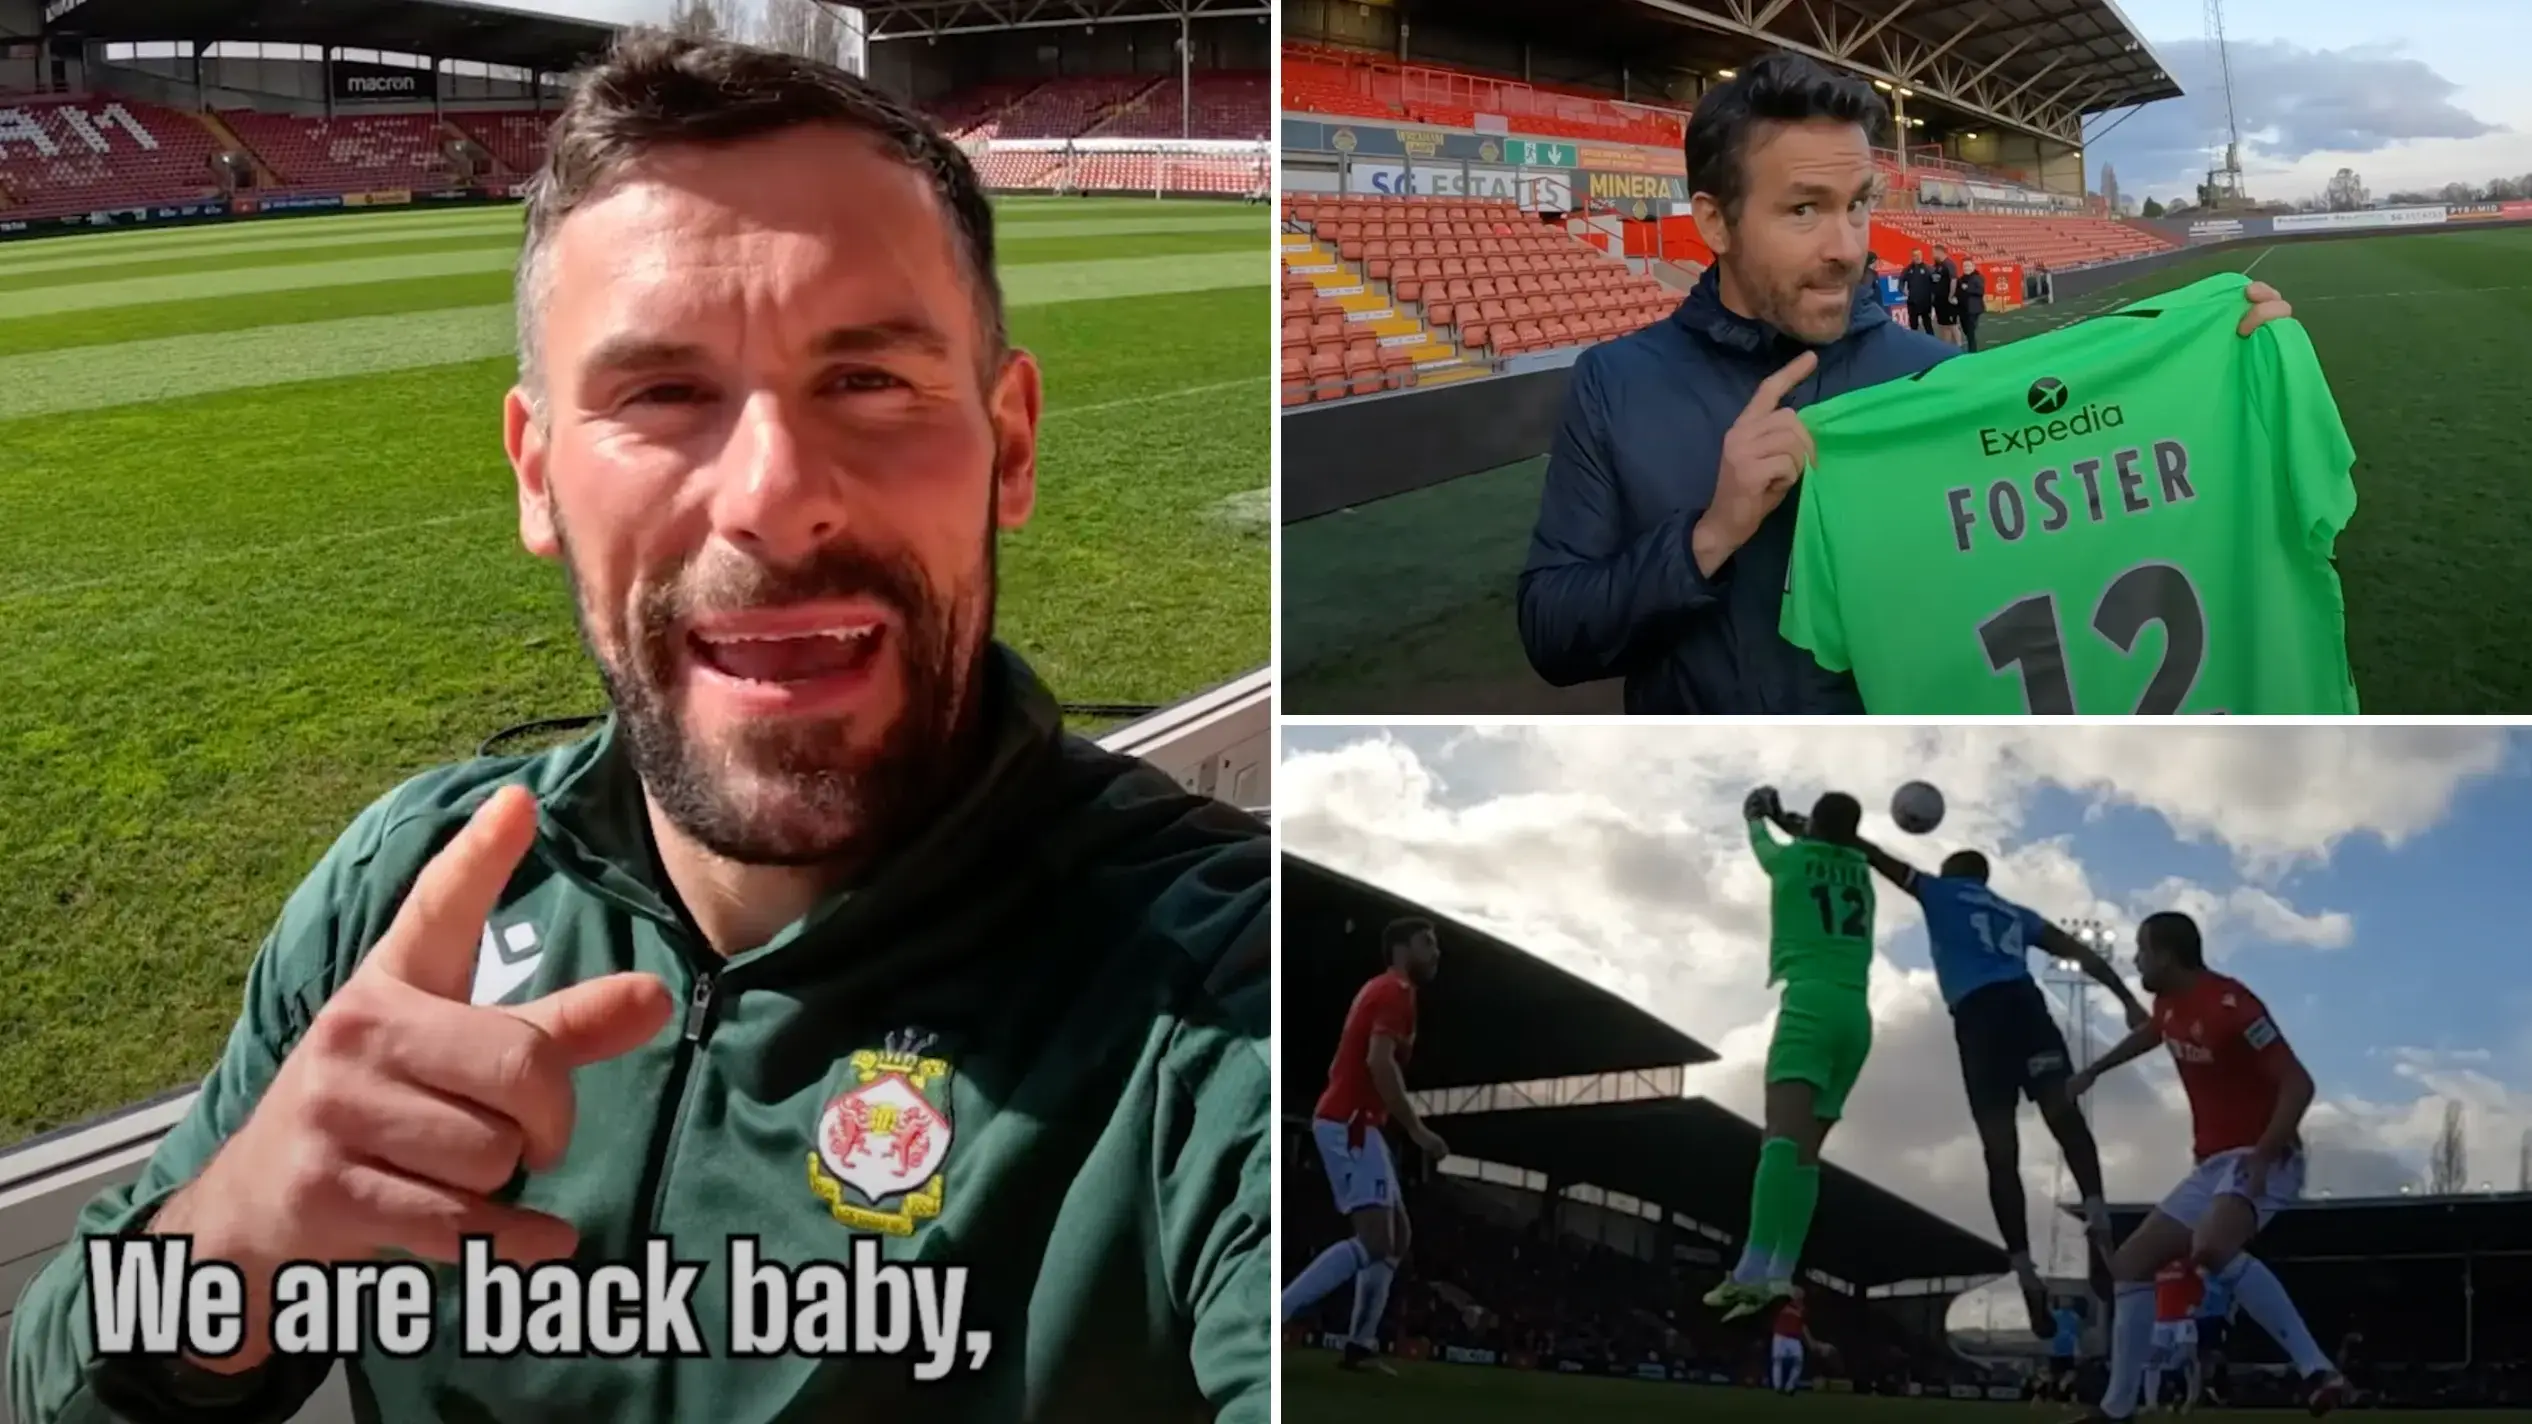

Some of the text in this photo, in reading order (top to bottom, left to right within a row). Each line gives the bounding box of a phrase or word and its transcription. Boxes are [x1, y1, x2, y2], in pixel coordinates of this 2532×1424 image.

[347, 76, 415, 92] macron
[1589, 172, 1671, 198] MINERA
[1979, 400, 2125, 458] Expedia
[1946, 439, 2197, 553] FOSTER
[1978, 562, 2227, 715] 12
[1809, 884, 1867, 938] 12
